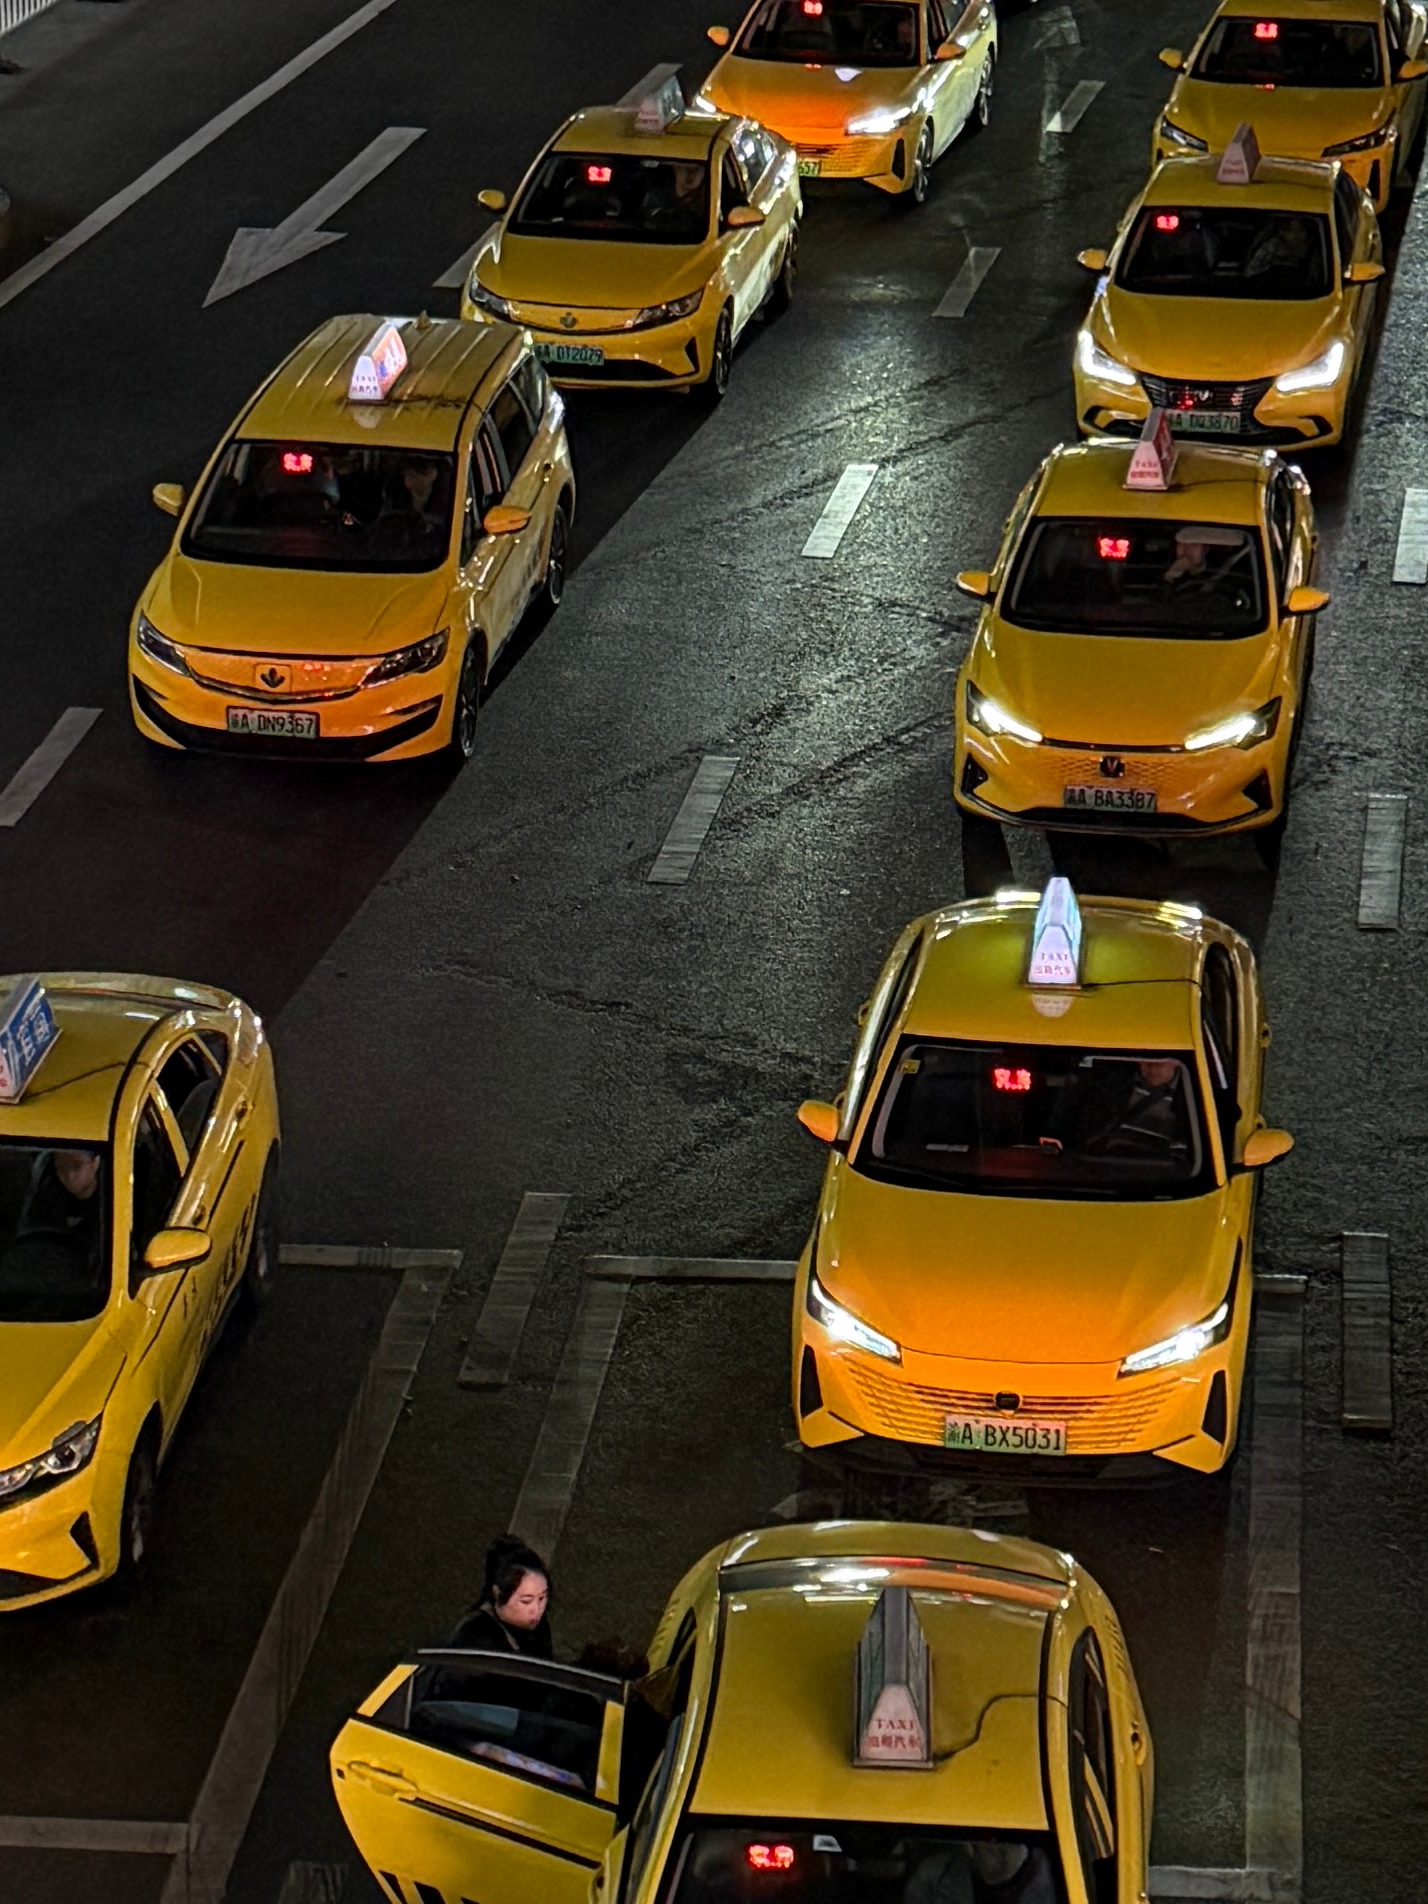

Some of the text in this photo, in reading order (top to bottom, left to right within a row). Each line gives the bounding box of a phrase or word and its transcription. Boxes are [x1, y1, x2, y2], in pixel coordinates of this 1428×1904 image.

[258, 715, 314, 734] DN9367
[984, 1424, 1065, 1451] BX5031
[876, 1719, 914, 1731] TAXI
